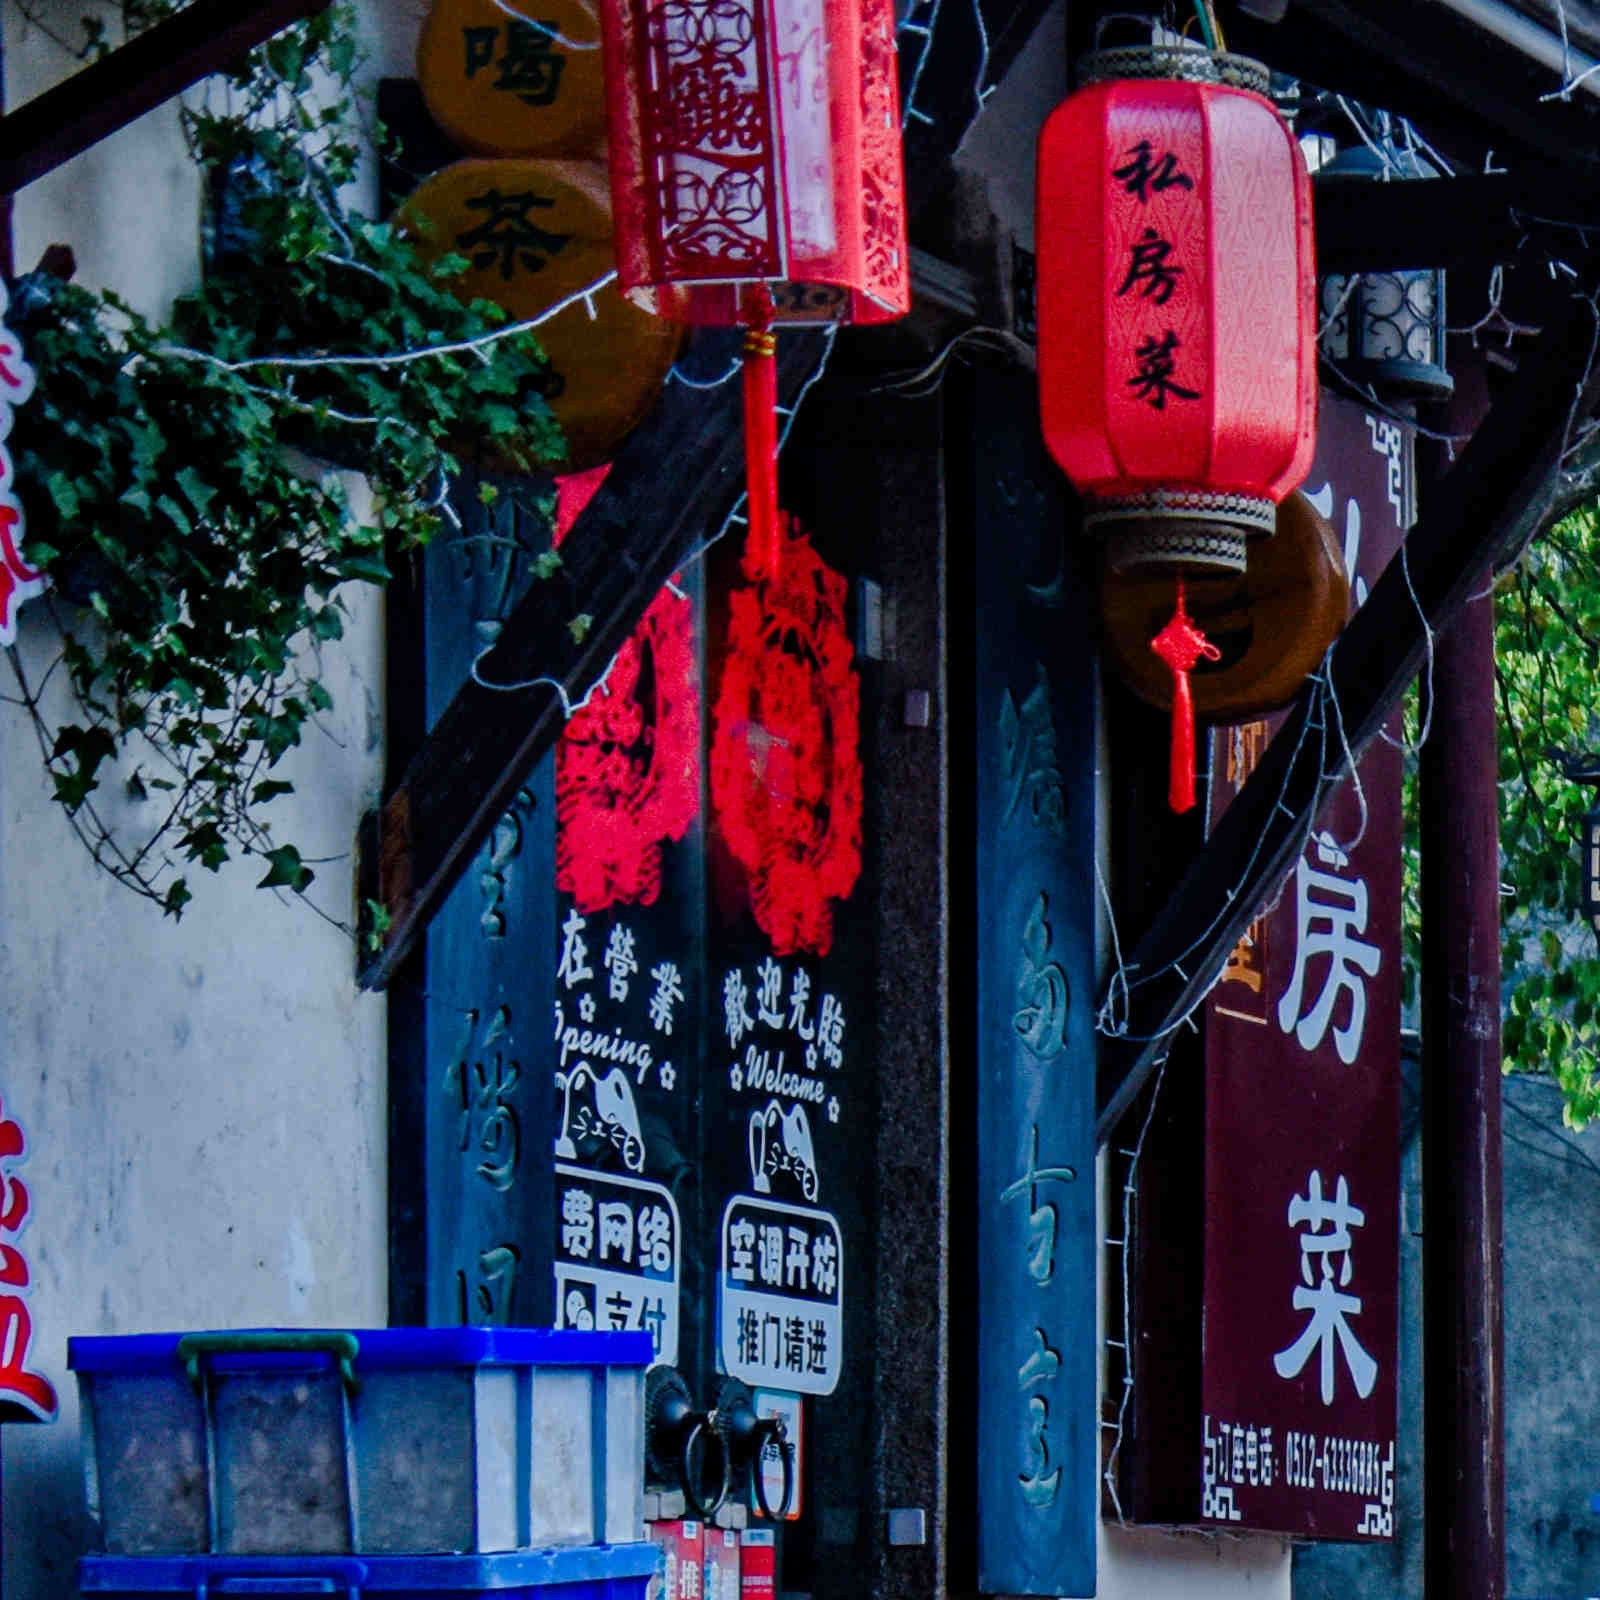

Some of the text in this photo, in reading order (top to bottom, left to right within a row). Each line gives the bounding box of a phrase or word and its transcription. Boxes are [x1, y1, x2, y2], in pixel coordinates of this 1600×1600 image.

[1112, 140, 1200, 410] 私房菜
[746, 1044, 826, 1104] Welcome
[730, 1217, 838, 1296] 空调开放
[736, 1306, 828, 1376] 推门请进
